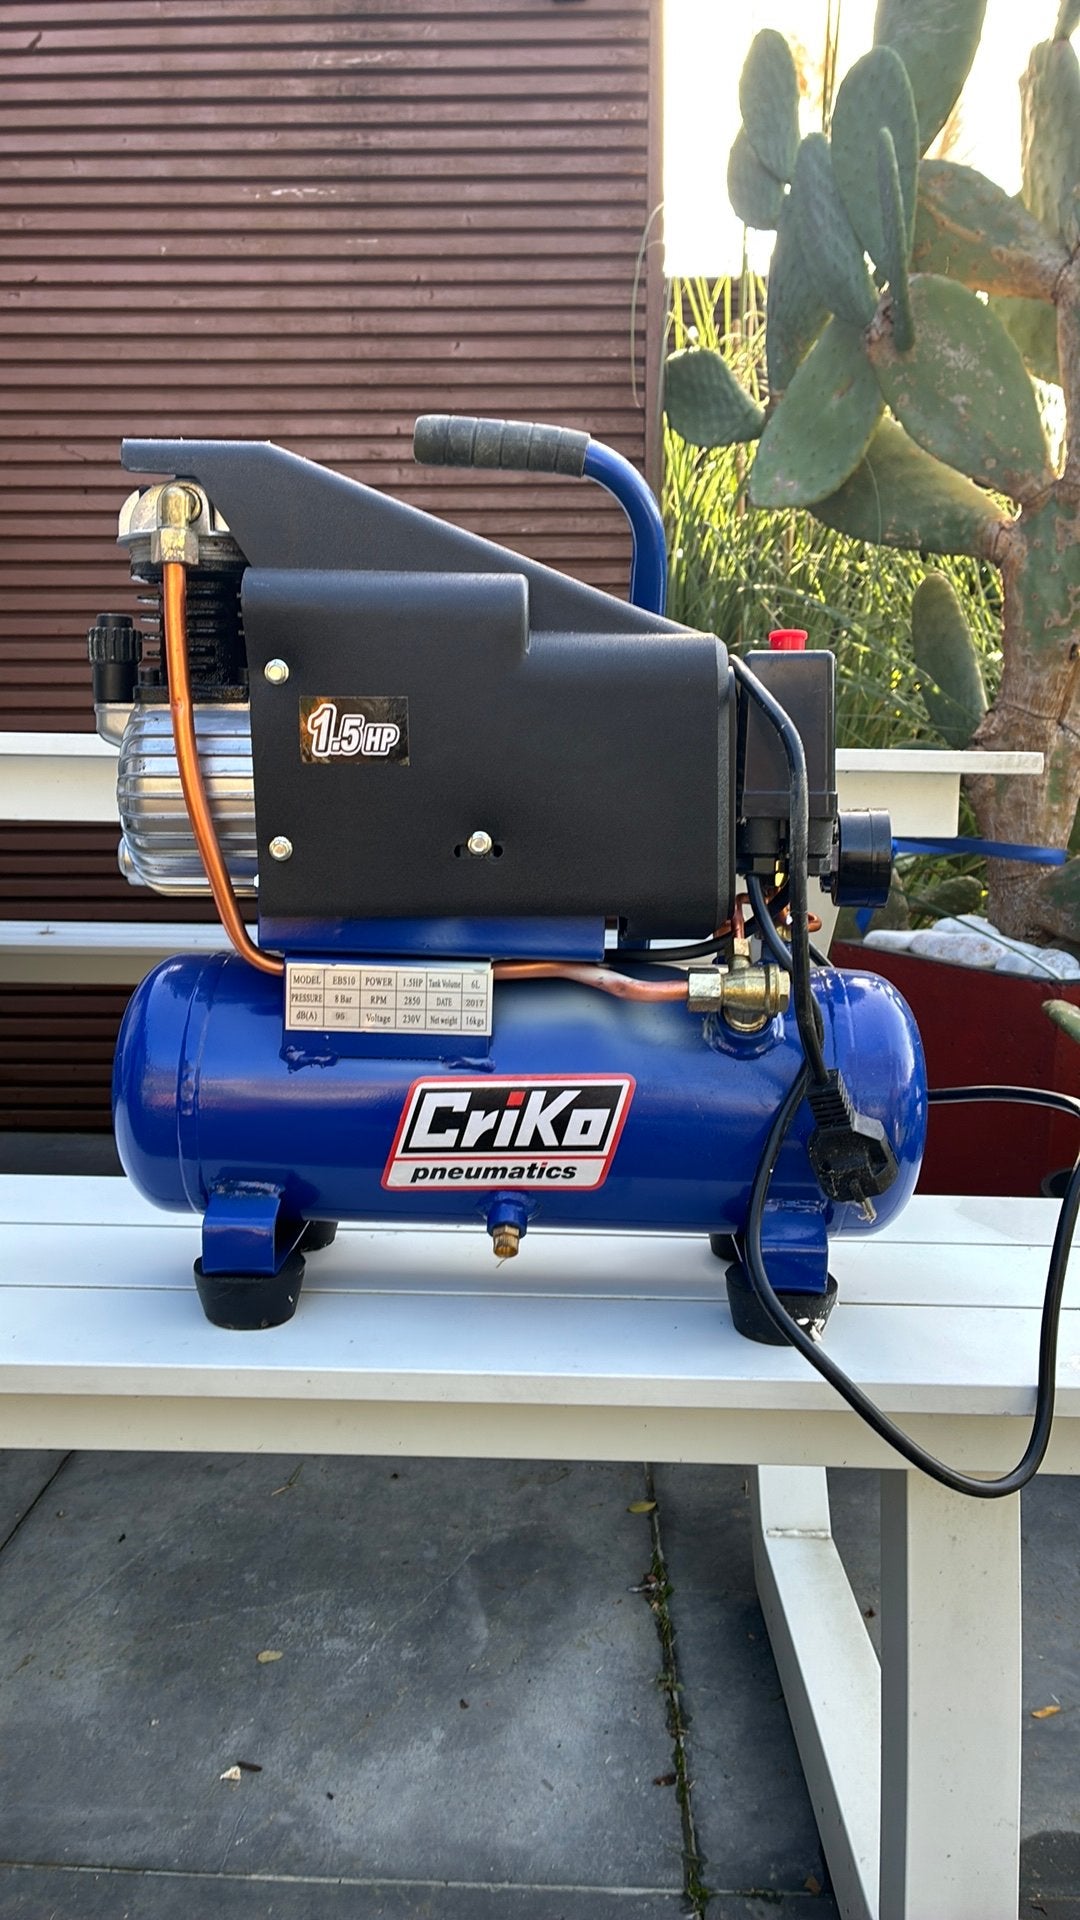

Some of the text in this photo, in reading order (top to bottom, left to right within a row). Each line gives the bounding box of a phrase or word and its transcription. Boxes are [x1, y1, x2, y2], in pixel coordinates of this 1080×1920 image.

[293, 975, 480, 990] MODEL EBS10 POWER 1.5HP Tank Volume 6L
[291, 993, 484, 1008] PRESSURE 8 Bar RPM 2850 DATE 2017
[296, 1010, 317, 1021] dB(A)
[366, 1013, 391, 1025] Voltage
[402, 1014, 421, 1024] 230V
[430, 1015, 440, 1025] Net
[440, 1015, 458, 1027] weight
[466, 1016, 485, 1028] 16kgs
[410, 1162, 578, 1183] pneumatics
